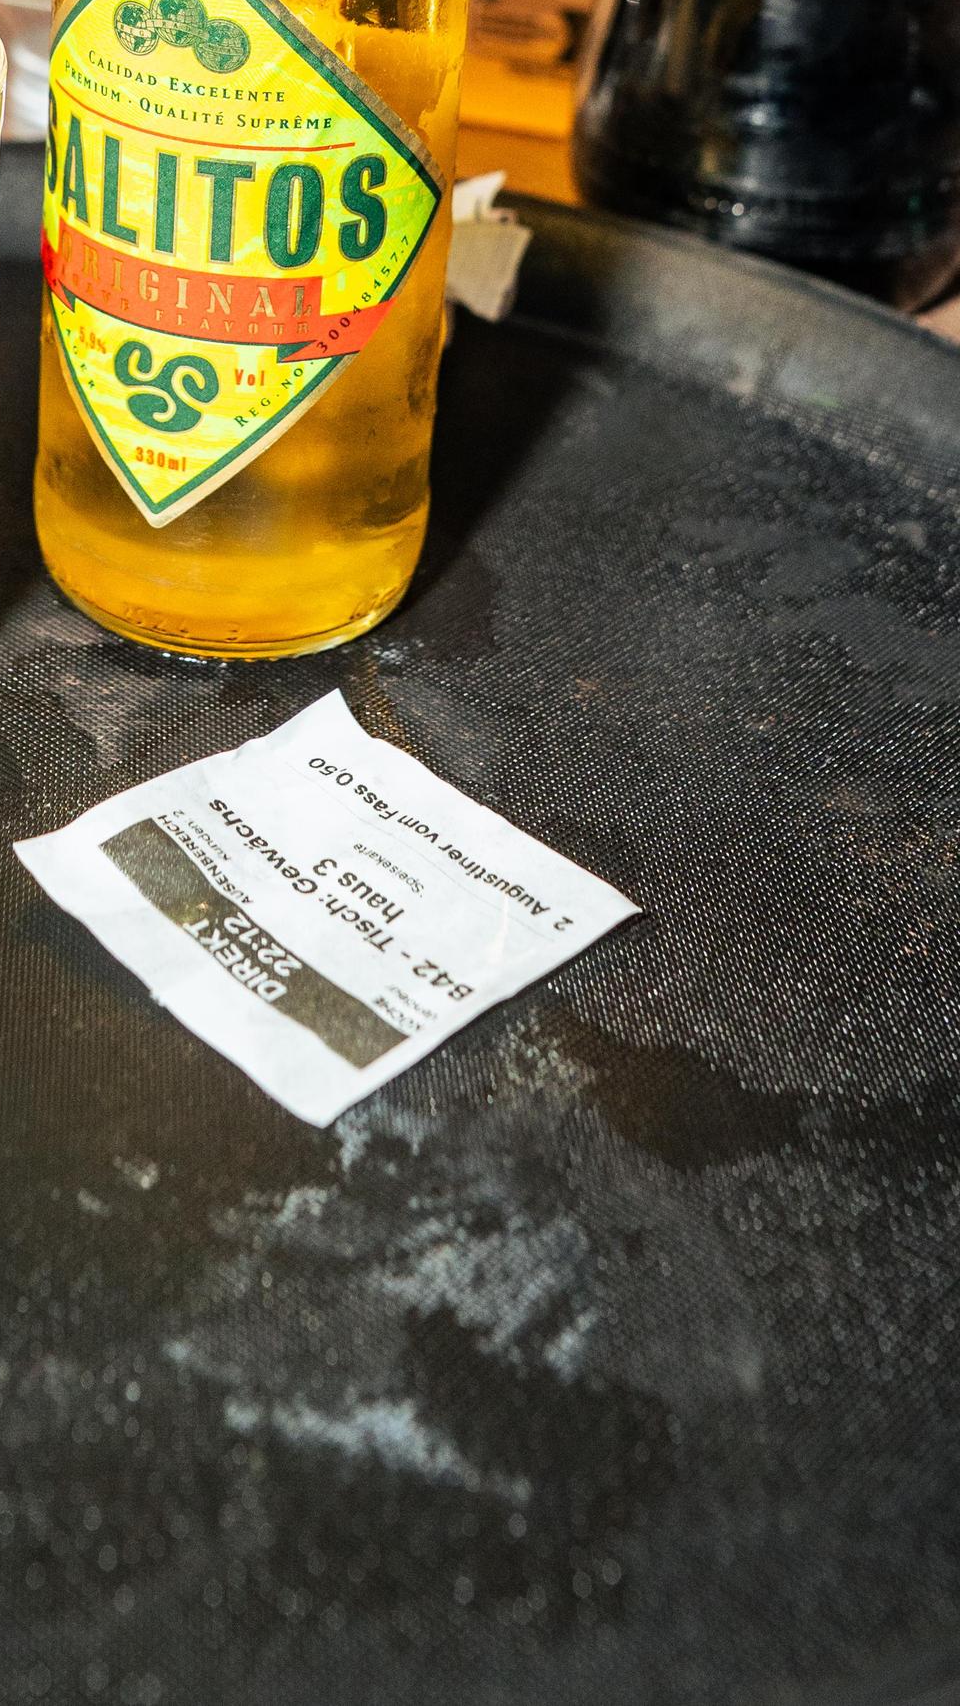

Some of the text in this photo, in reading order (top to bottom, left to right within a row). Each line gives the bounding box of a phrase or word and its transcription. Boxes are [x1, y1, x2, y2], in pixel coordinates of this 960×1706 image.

[65, 59, 333, 130] PREMIUM QUALITÉ SUPRÊME
[88, 50, 286, 102] CALIDAD EXCELENTE
[46, 88, 389, 271] SALITOS
[60, 224, 313, 319] ORIGINAL
[155, 309, 311, 336] FLAVOUR
[234, 367, 266, 387] Vol
[135, 446, 187, 473] 330ml
[156, 813, 254, 906] AUSENBEREICH
[208, 797, 319, 895] Gewächs
[307, 756, 575, 933] 2 Augustiner vom Fass 0,50
[311, 857, 406, 924] haus 3
[182, 916, 289, 1005] DIREKT
[222, 910, 305, 979] 22:12
[411, 958, 476, 1003] B42
